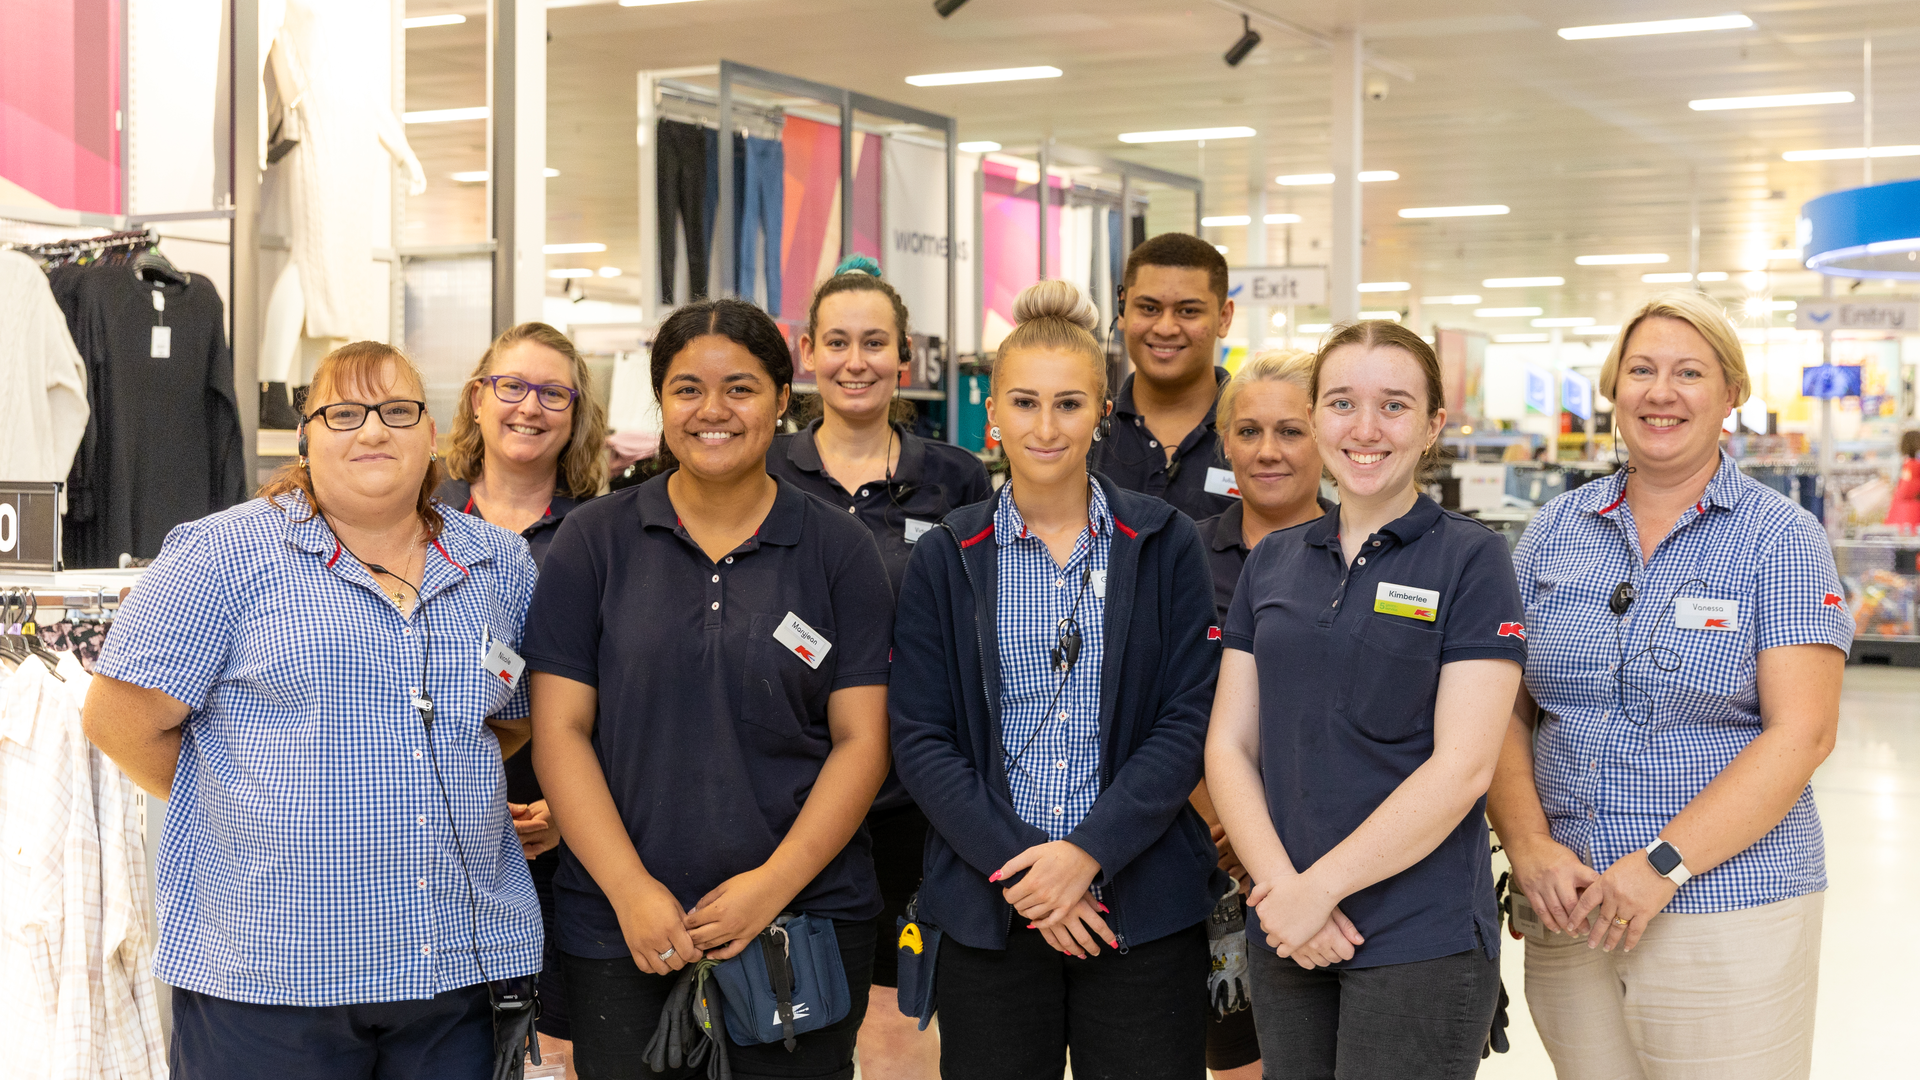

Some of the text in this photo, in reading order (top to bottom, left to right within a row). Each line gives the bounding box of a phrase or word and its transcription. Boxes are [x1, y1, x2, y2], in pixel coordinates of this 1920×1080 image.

[893, 229, 967, 261] womes
[1252, 276, 1298, 300] Exit
[1838, 304, 1905, 327] Entry
[917, 346, 941, 384] 15
[1380, 602, 1386, 610] 5
[1388, 590, 1428, 604] Kimberlee
[1692, 603, 1724, 612] Vanessa
[791, 621, 818, 646] Maryjean
[498, 651, 511, 666] Nicole
